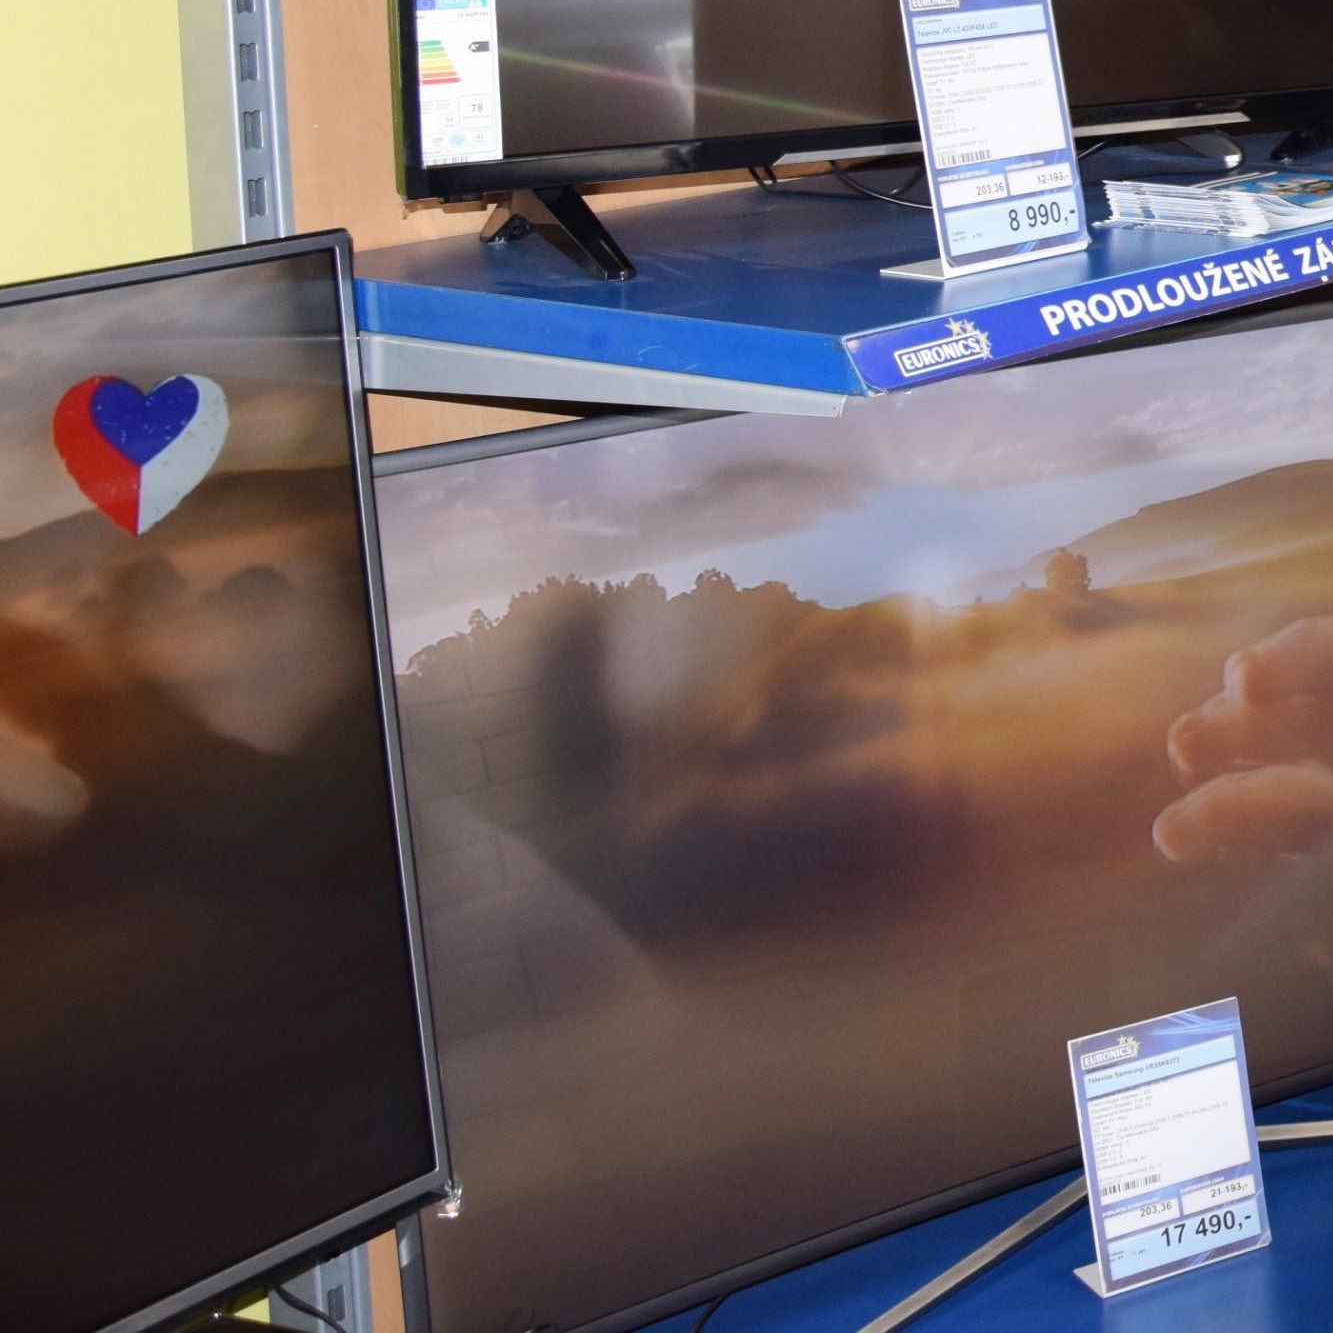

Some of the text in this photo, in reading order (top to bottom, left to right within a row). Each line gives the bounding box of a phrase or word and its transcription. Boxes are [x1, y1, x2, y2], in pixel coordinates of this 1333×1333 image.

[976, 182, 1005, 196] 203,36
[1008, 201, 1075, 231] 8 990,-
[902, 336, 980, 368] EURONICS
[1040, 252, 1287, 335] PRODLOUŽENÉ
[1085, 1045, 1133, 1067] EURONICS
[1088, 1066, 1145, 1084] Televize Samsung
[1139, 1187, 1222, 1218] 203,36 21
[1161, 1209, 1252, 1248] 17 490,-
